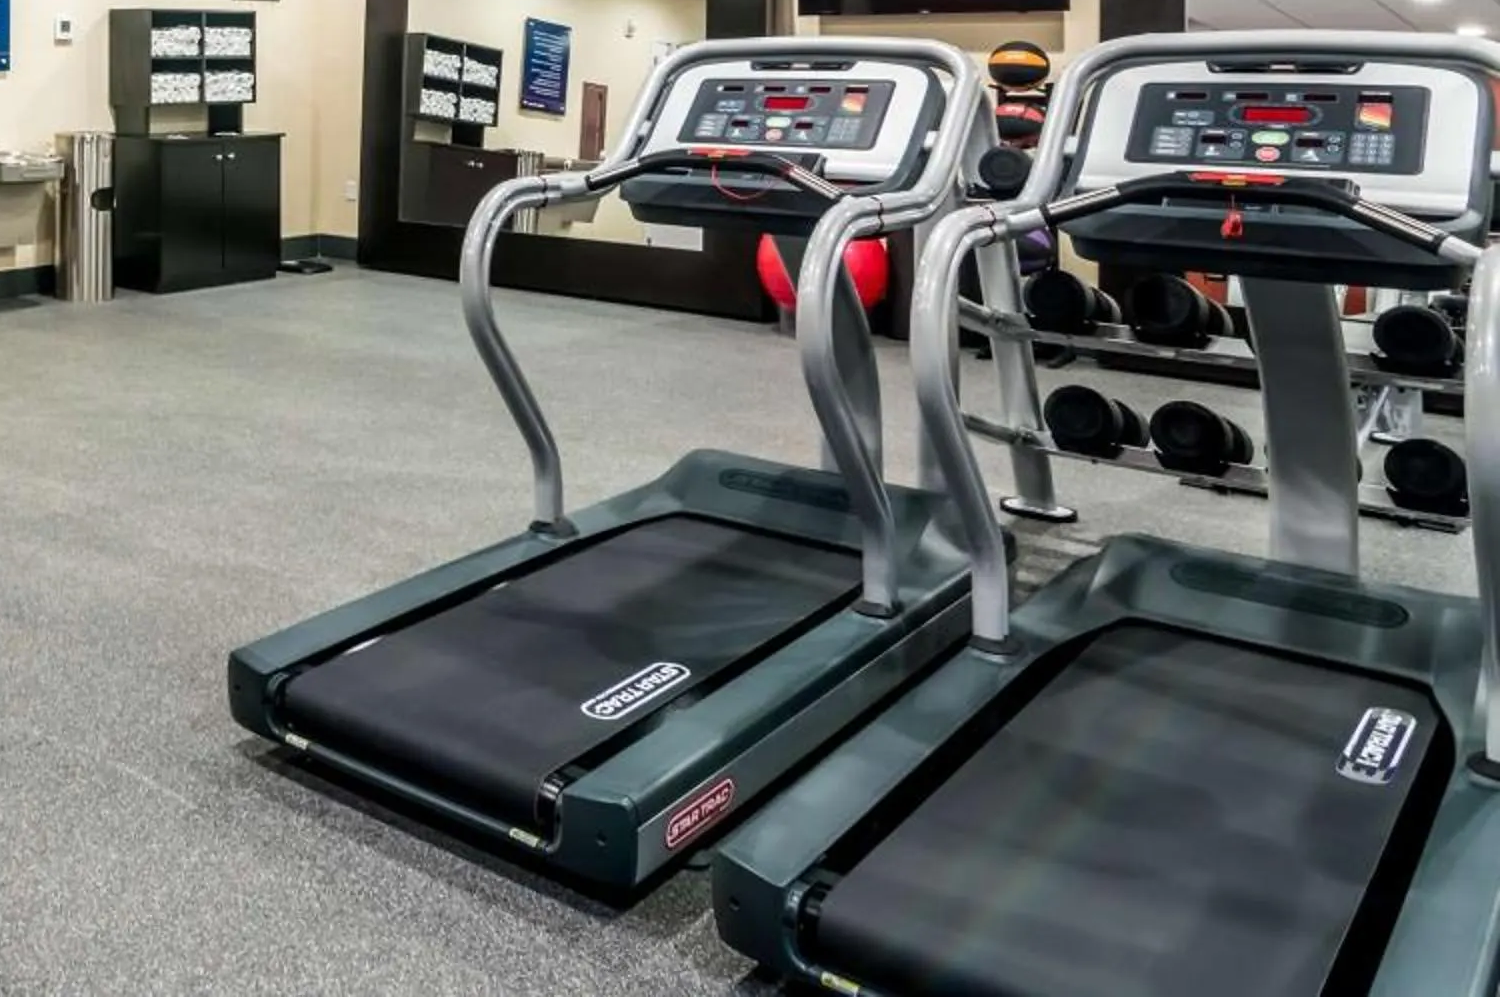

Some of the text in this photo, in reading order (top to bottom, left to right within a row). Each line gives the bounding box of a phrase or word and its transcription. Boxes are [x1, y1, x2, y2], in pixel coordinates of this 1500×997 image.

[595, 666, 679, 715] STAR TRAC
[671, 787, 730, 836] STAR TRAC
